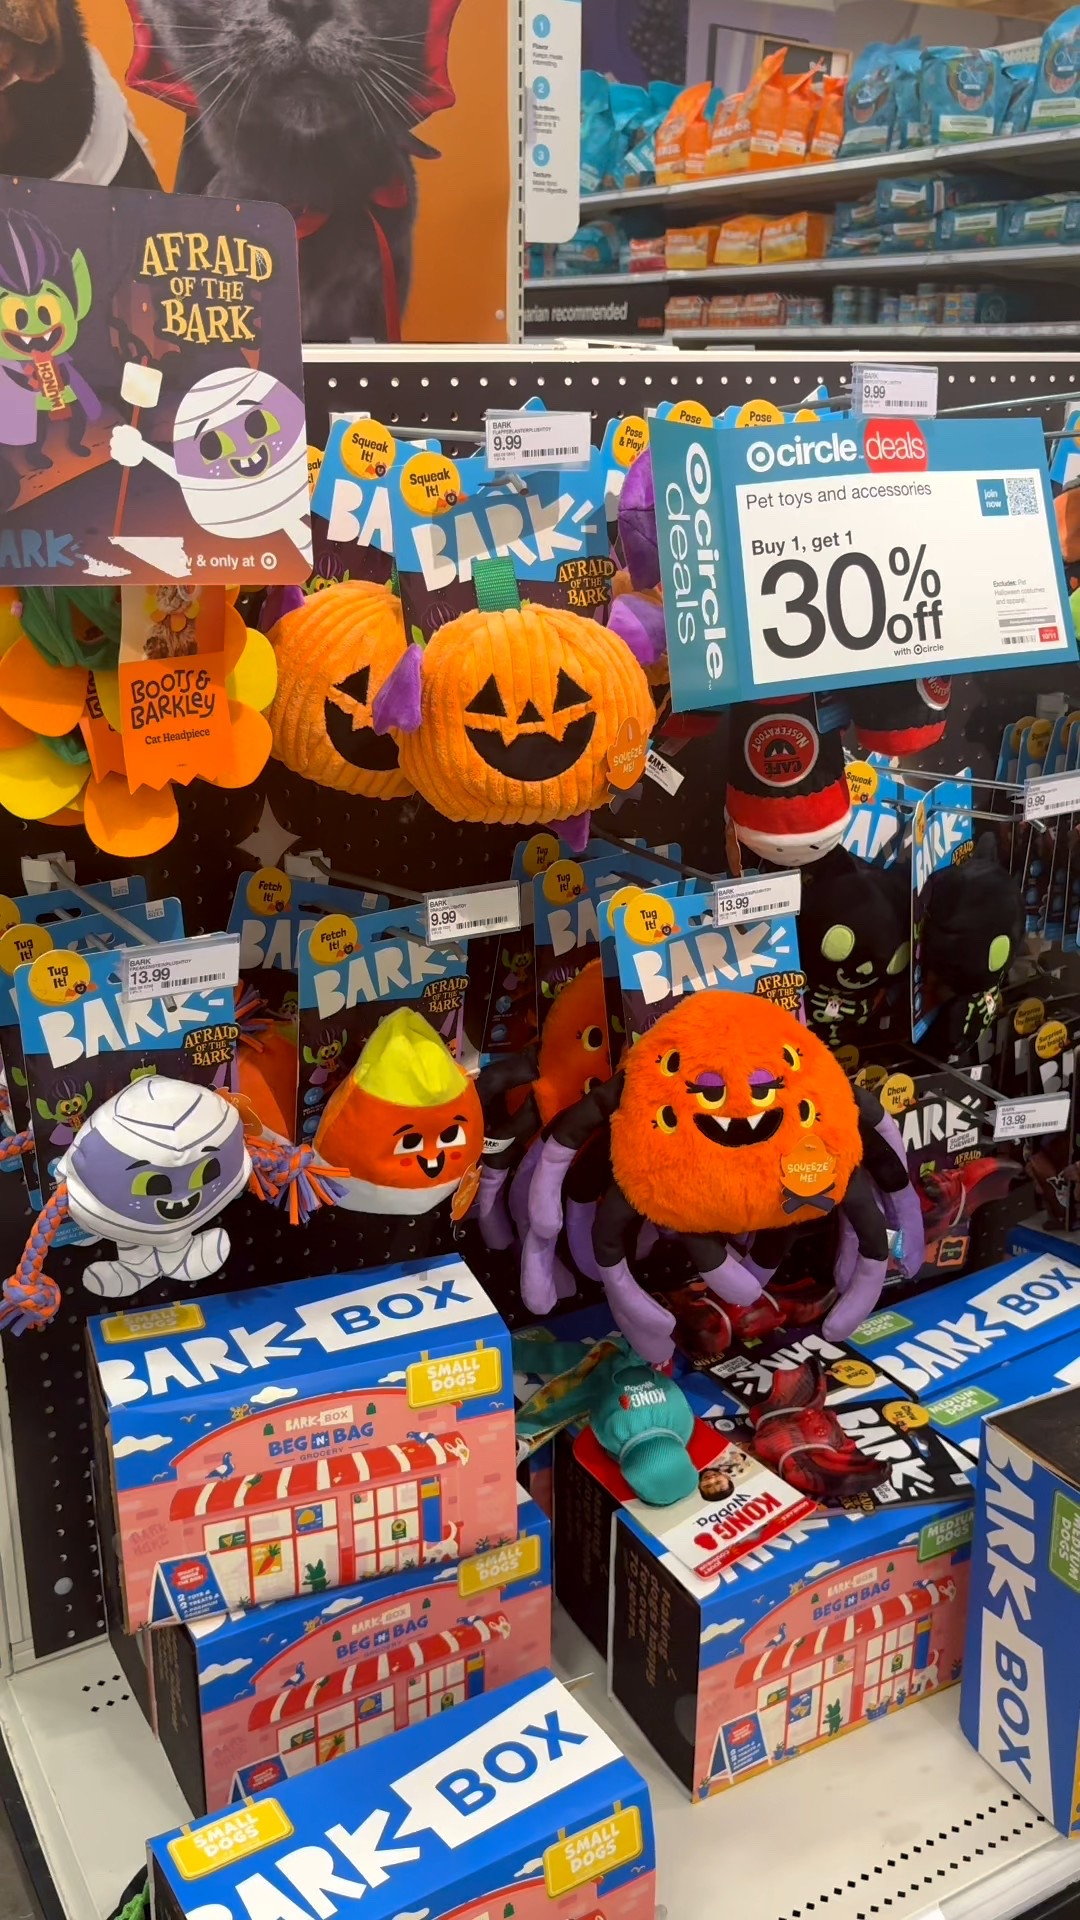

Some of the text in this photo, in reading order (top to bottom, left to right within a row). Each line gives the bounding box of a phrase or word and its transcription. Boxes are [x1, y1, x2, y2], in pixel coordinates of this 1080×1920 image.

[140, 232, 273, 281] AFRAID
[170, 278, 244, 301] OF THE
[551, 302, 629, 321] recommended
[161, 300, 255, 344] BARK
[39, 362, 66, 411] MUNCH
[864, 385, 886, 399] 9.99
[680, 410, 702, 424] Pose
[750, 411, 772, 423] Pose
[625, 426, 643, 439] Pose
[351, 432, 389, 453] Squeak
[493, 435, 522, 451] 9.99
[619, 437, 645, 452] & Play!
[777, 431, 926, 467] circle deals
[361, 449, 374, 463] It!
[409, 468, 451, 486] Squeak
[425, 484, 440, 498] It!
[746, 481, 932, 510] Pet toys and accessories
[984, 489, 998, 500] join
[986, 501, 1002, 509] now
[0, 529, 73, 570] ARK
[411, 493, 584, 592] BARK
[752, 530, 854, 557] Buy 1, get 1
[196, 554, 207, 569] &
[210, 553, 238, 571] only
[240, 555, 255, 569] at
[558, 557, 614, 582] AFRAID
[665, 482, 696, 645] deals
[570, 577, 602, 588] OF THE
[567, 586, 609, 607] BARK
[695, 510, 727, 680] circle
[886, 600, 943, 646] off
[894, 644, 944, 657] with circle
[131, 669, 193, 704] BOOTS
[195, 669, 211, 691] &
[145, 727, 211, 747] Cat Headpiece
[613, 747, 643, 767] SQUEEZE
[647, 754, 668, 773] BARK
[623, 762, 636, 773] ME!
[846, 771, 872, 787] Squeak
[850, 782, 861, 793] It!
[1027, 795, 1046, 808] 9.99
[916, 811, 963, 898] BARK
[258, 880, 283, 893] Fetch
[556, 872, 571, 885] Tug
[560, 881, 569, 893] It!
[263, 892, 274, 903] It!
[430, 900, 448, 908] BARK
[719, 897, 750, 912] 13.99
[431, 911, 456, 926] 9.99
[640, 909, 658, 922] Tug
[644, 919, 657, 931] It!
[320, 928, 347, 943] Fetch
[14, 939, 34, 951] Tug
[329, 940, 341, 952] It!
[20, 950, 33, 961] It!
[130, 958, 152, 967] BARK
[633, 921, 778, 1005] BARK
[47, 966, 69, 977] Tug
[130, 967, 171, 985] 13.99
[53, 977, 67, 989] It!
[313, 941, 449, 1021] BARK
[424, 978, 469, 998] AFRAID
[756, 973, 805, 995] AFRAID
[432, 992, 442, 1001] OF
[766, 986, 795, 997] OF THE
[428, 998, 461, 1014] BARK
[38, 990, 210, 1069] BARK
[184, 1026, 239, 1049] AFRAID
[196, 1040, 227, 1052] OF THE
[192, 1050, 232, 1066] BARK
[887, 1086, 907, 1096] Chew
[892, 1095, 901, 1105] It!
[902, 1101, 972, 1152] ARK
[1001, 1114, 1026, 1127] 13.99
[950, 1133, 970, 1144] SUPER
[950, 1137, 976, 1150] CHEWER
[787, 1161, 830, 1174] SQUEEZE
[800, 1173, 817, 1183] ME!
[125, 1309, 178, 1323] SMALL
[130, 1320, 177, 1332] DOGS
[863, 1322, 894, 1336] DOGS
[873, 1267, 1080, 1392] BARK BOX
[98, 1279, 474, 1408] BARK BOX
[427, 1358, 480, 1380] SMALL
[431, 1373, 476, 1391] DOGS
[631, 1388, 667, 1408] KONG
[928, 1389, 978, 1415] MEDIUM
[946, 1399, 978, 1416] DOGS
[285, 1410, 348, 1432] BARK BOX
[269, 1436, 308, 1456] BEG
[333, 1422, 374, 1443] BAG
[300, 1447, 344, 1461] GROCERY
[836, 1407, 935, 1490] BARK
[696, 1493, 752, 1527] Wubba
[712, 1491, 783, 1540] KONG
[936, 1524, 969, 1545] DOGS
[1059, 1516, 1071, 1561] DOGS
[475, 1547, 524, 1571] SMALL
[478, 1559, 519, 1583] DOGS
[177, 1593, 185, 1602] 2
[180, 1602, 188, 1610] 2
[813, 1578, 890, 1621] BEG BAG
[986, 1426, 1036, 1785] BARK BOX
[336, 1635, 371, 1659] BEG
[393, 1614, 429, 1638] BAG
[186, 1710, 589, 1920] ARK BOX
[193, 1813, 259, 1848] SMALL
[203, 1826, 260, 1858] DOGS
[565, 1823, 621, 1860] SMALL
[569, 1841, 617, 1874] DOGS
